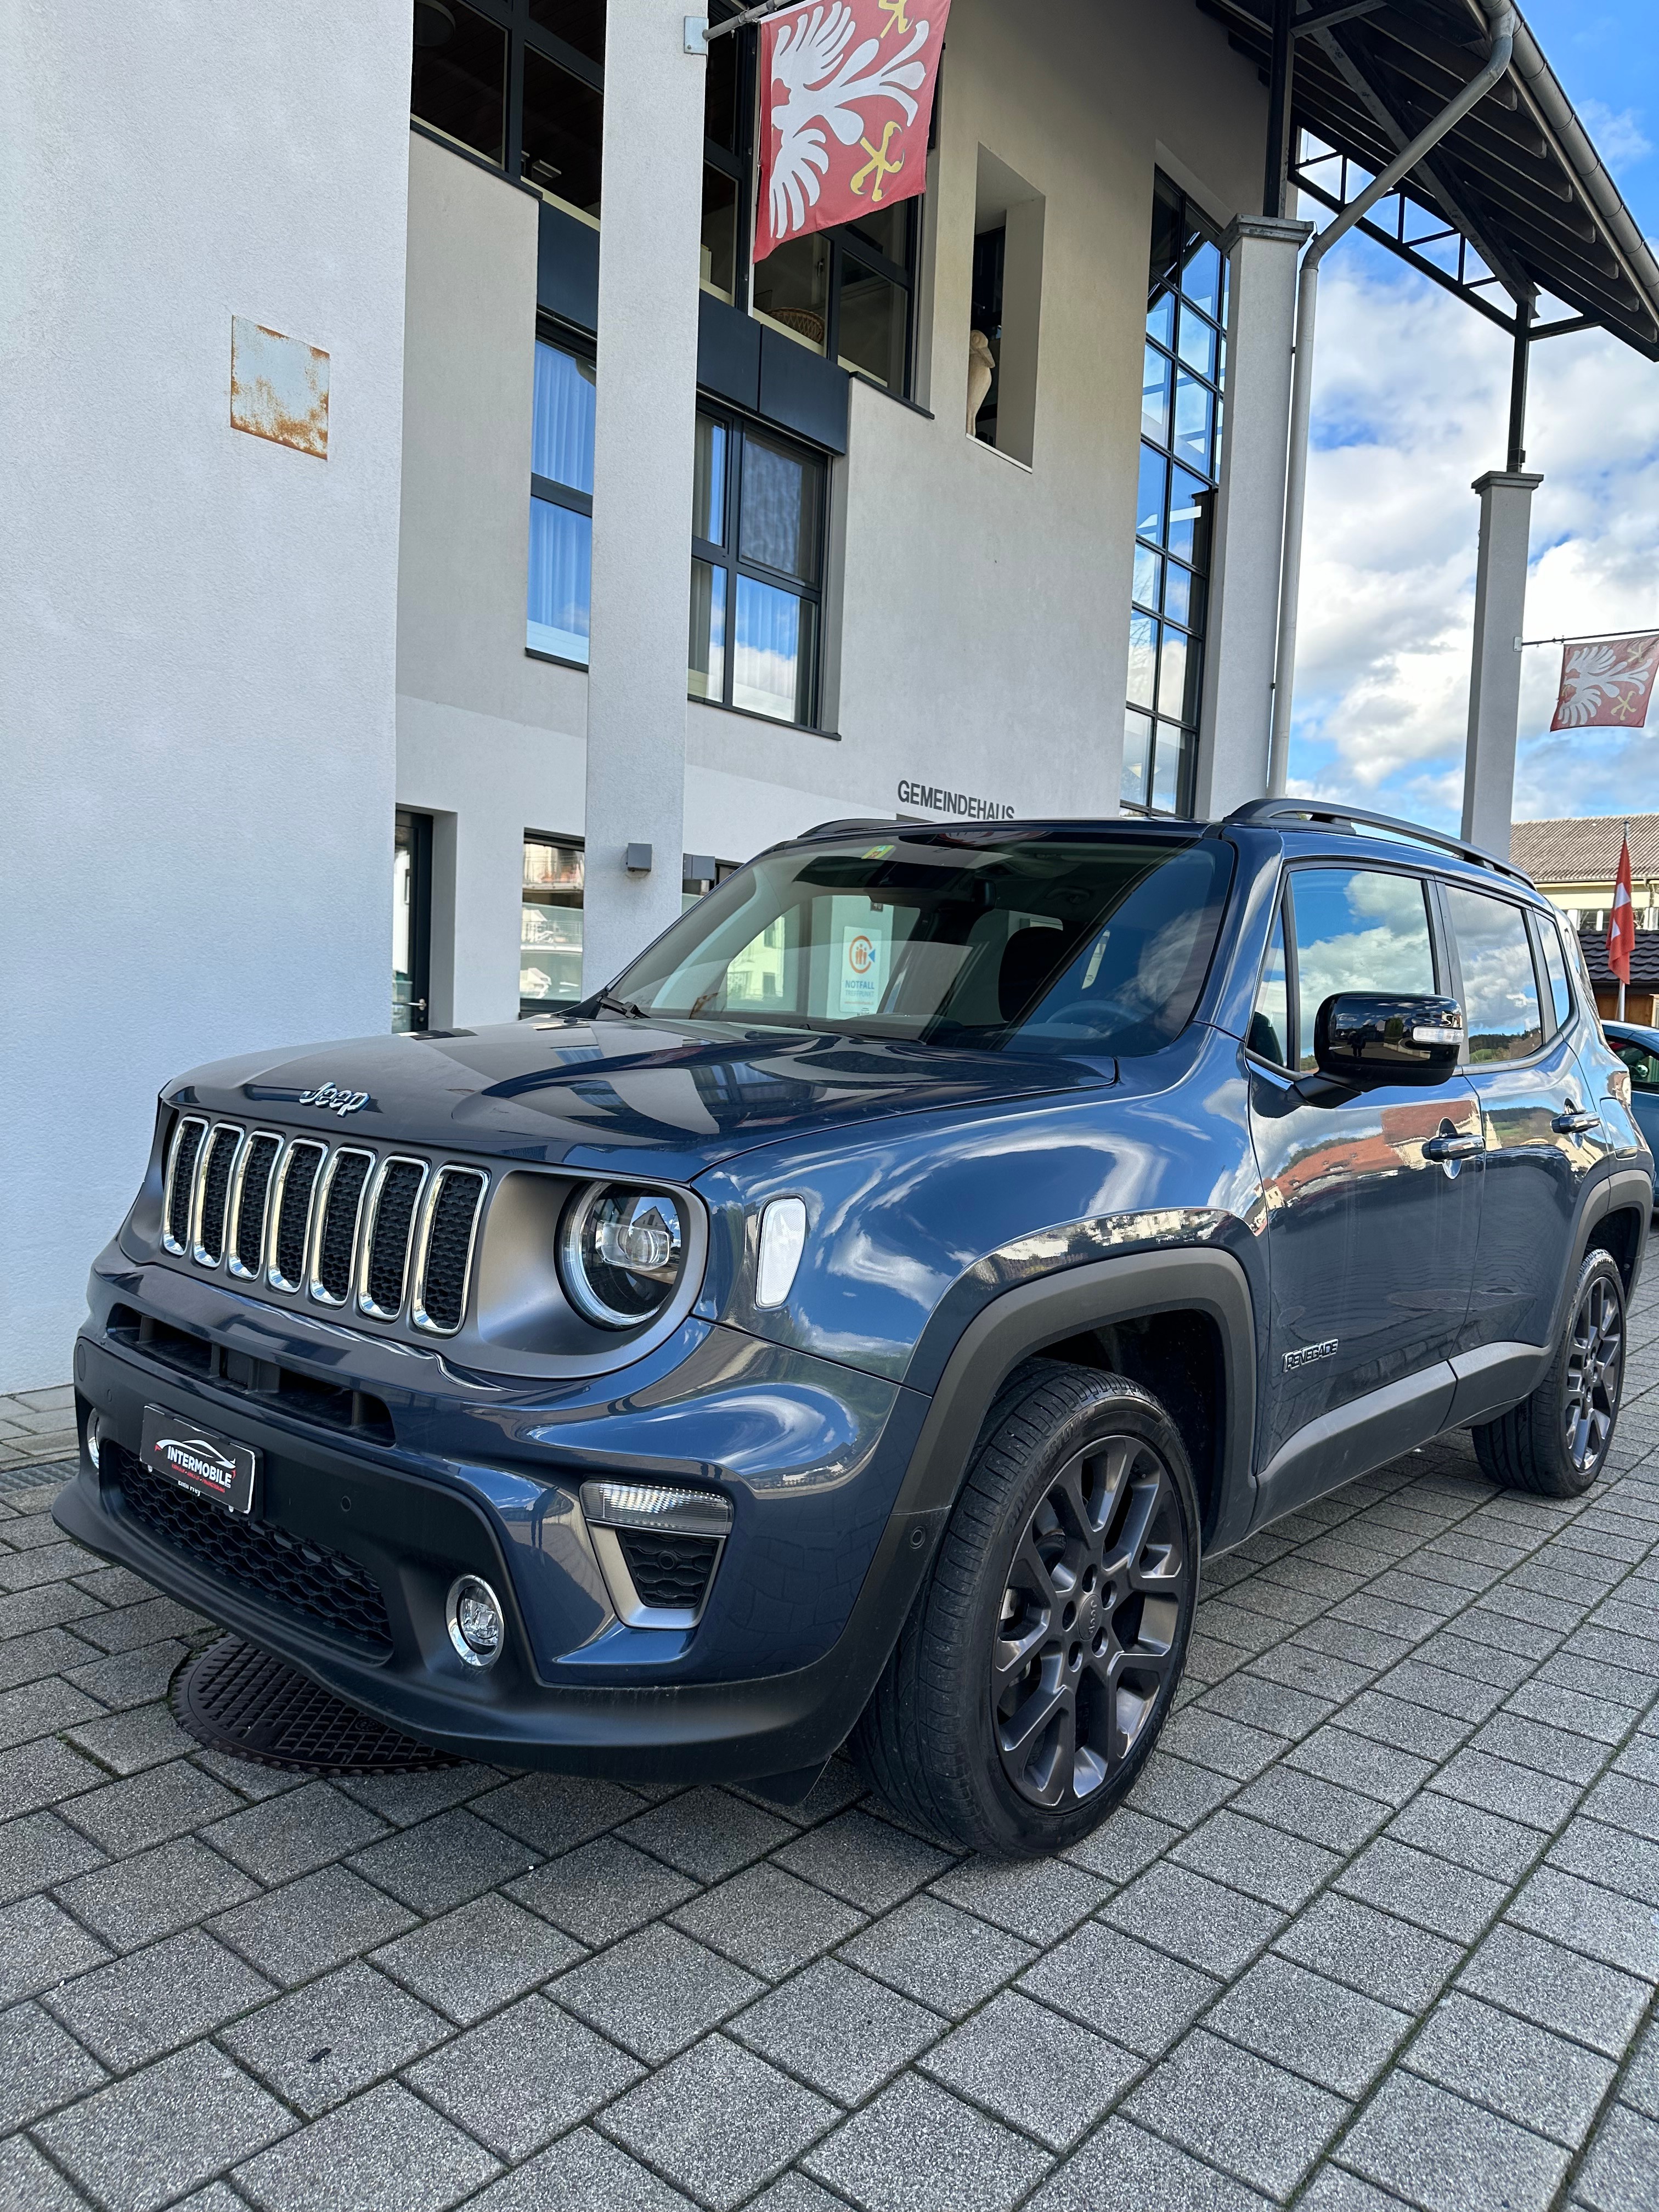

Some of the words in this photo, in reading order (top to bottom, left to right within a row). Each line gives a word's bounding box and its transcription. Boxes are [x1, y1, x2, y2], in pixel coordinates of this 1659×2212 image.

[898, 780, 1014, 820] GEMEINDEHAUS
[845, 980, 874, 989] NOTFALL
[299, 1082, 370, 1118] Jeep
[1282, 1339, 1339, 1373] RENEGADE
[167, 1446, 232, 1488] INTERMOBILE
